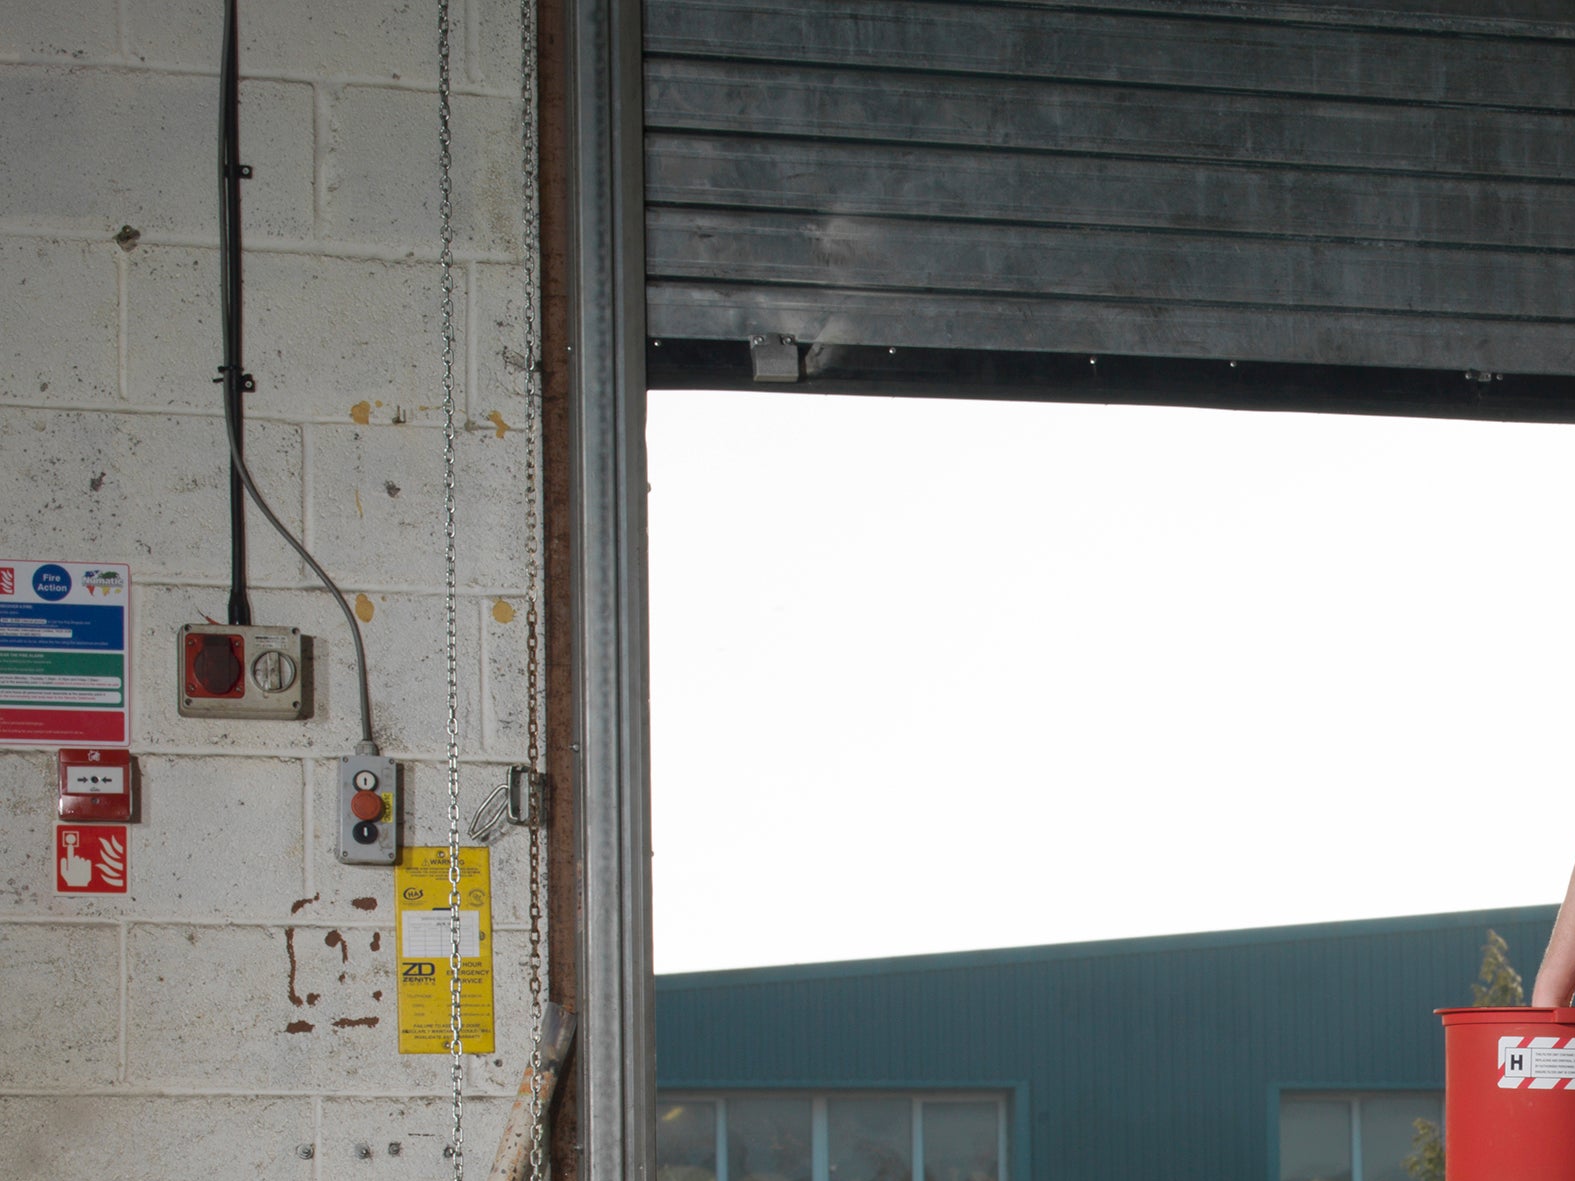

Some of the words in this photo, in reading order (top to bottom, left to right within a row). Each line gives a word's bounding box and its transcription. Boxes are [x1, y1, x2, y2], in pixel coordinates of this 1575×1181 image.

[43, 574, 61, 582] Fire
[37, 584, 68, 593] Action
[402, 962, 435, 976] ZD
[1510, 1054, 1523, 1071] H
